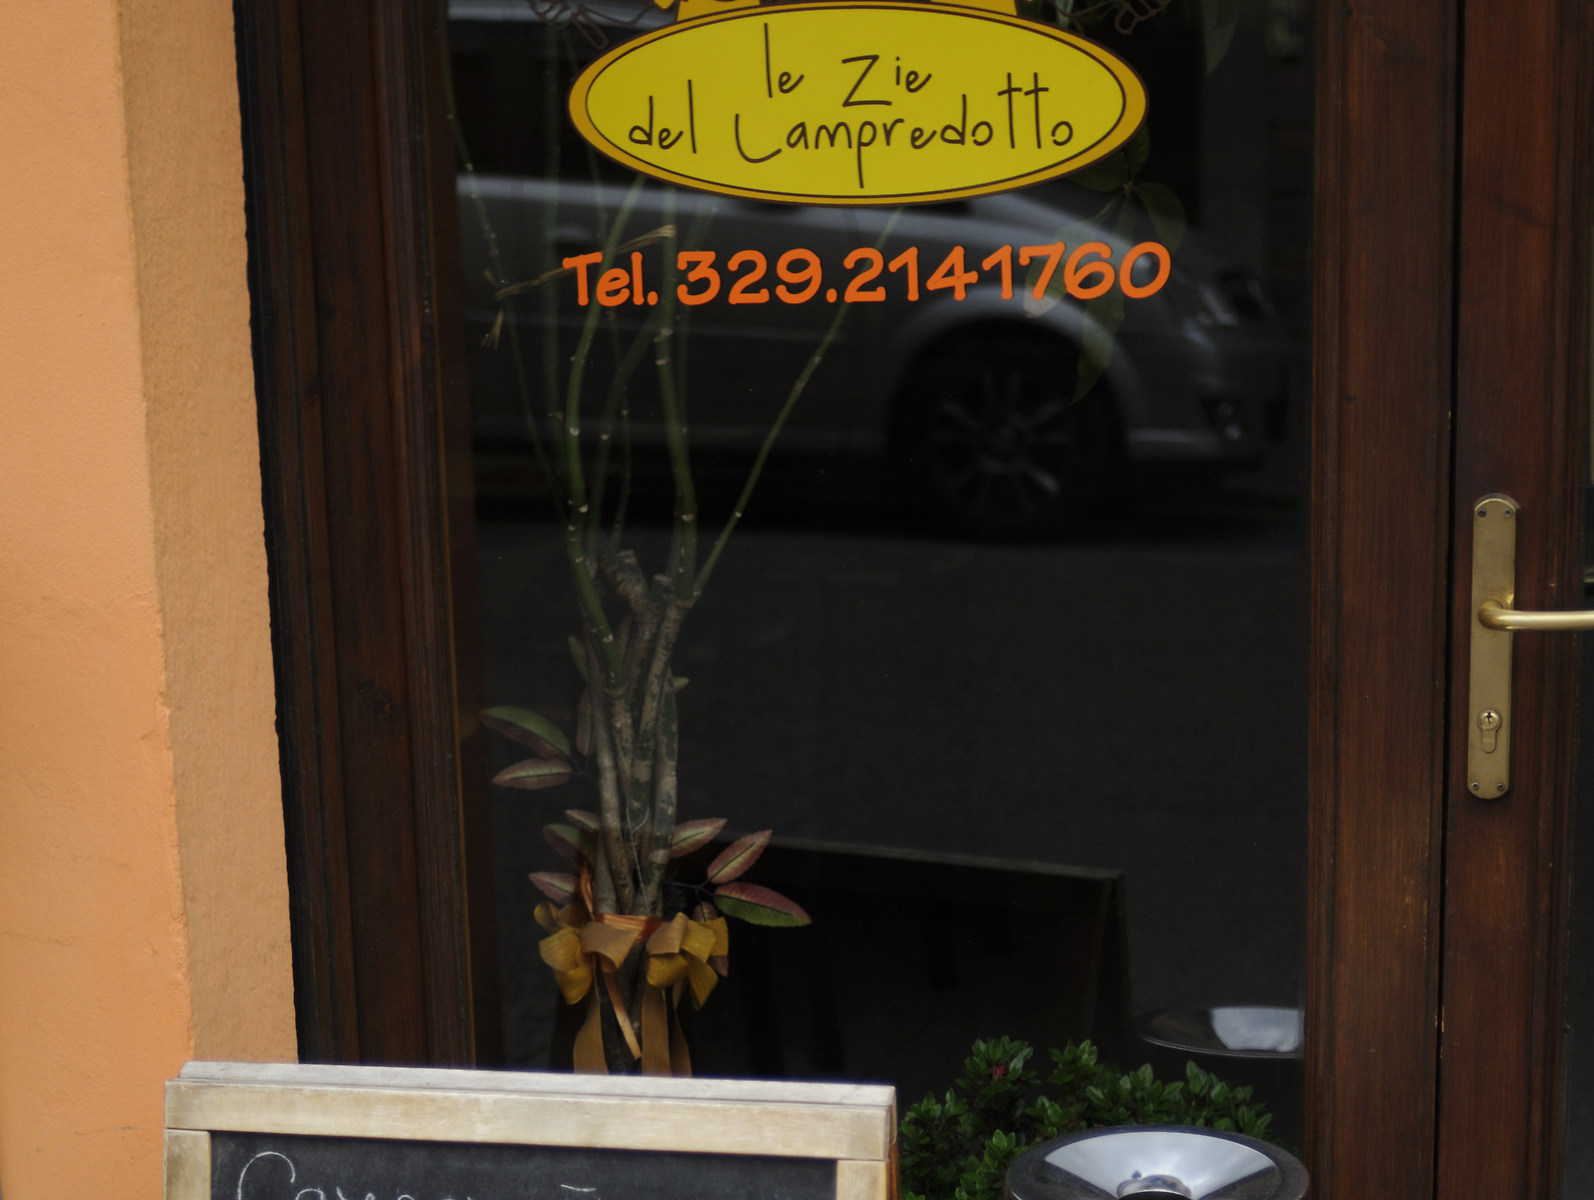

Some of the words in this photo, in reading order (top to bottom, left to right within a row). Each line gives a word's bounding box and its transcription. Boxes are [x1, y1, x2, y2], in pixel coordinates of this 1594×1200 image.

[764, 22, 805, 98] le
[841, 54, 932, 108] Zie
[628, 79, 697, 154] del
[734, 72, 1074, 189] Lampredotto
[562, 251, 659, 306] Tel.
[676, 241, 1171, 305] 329.2141760
